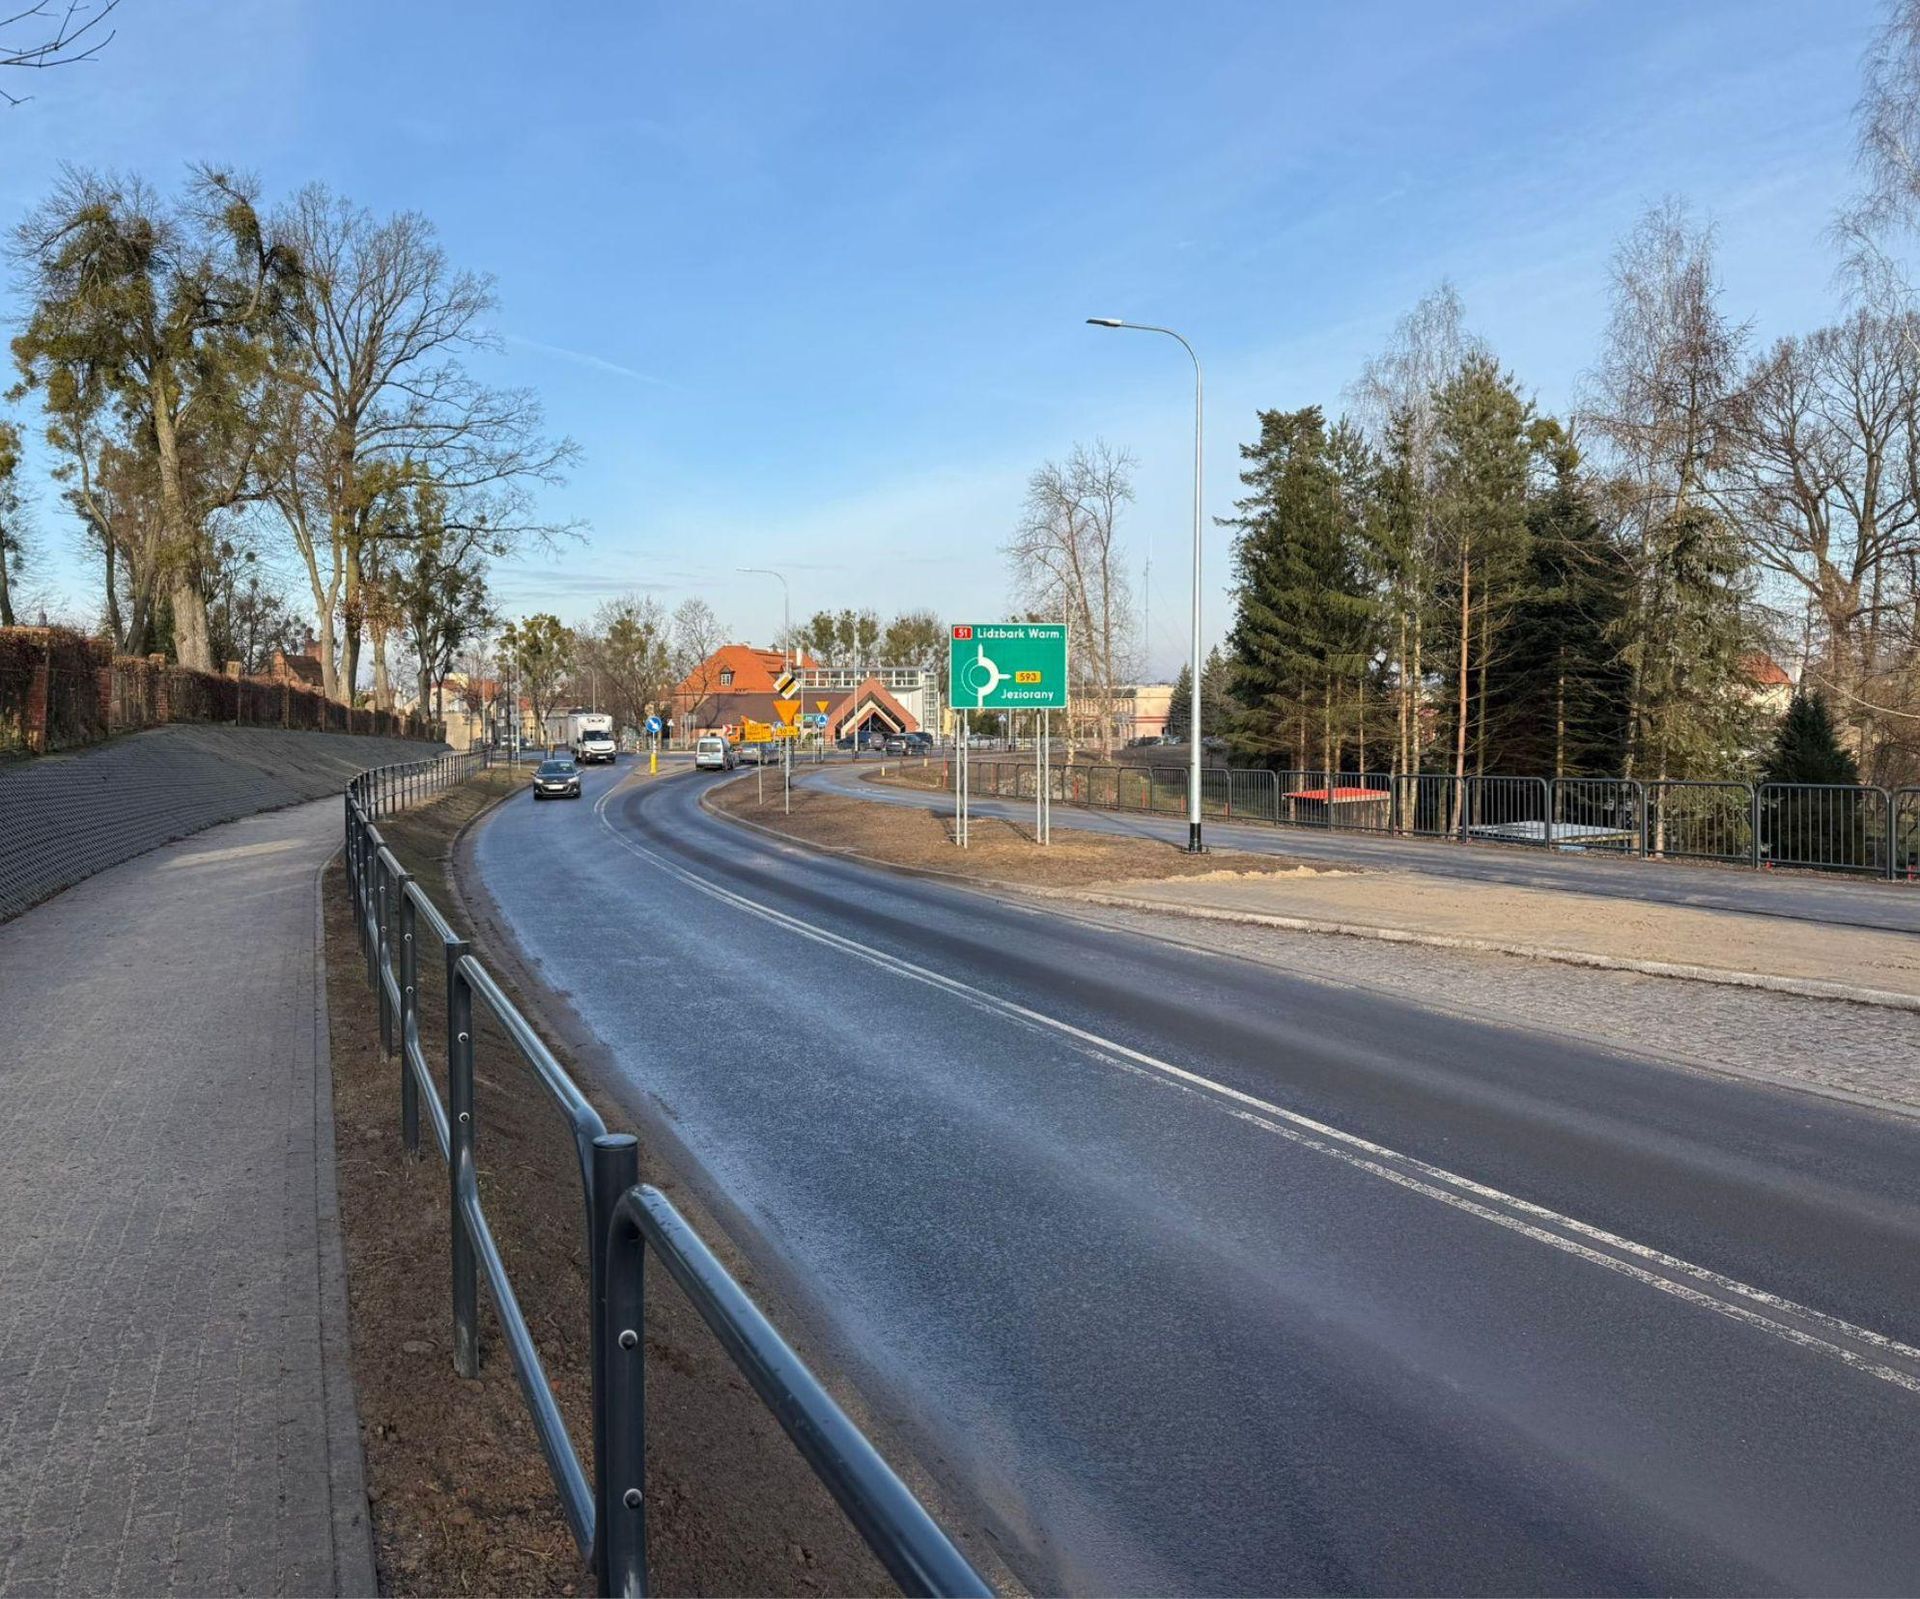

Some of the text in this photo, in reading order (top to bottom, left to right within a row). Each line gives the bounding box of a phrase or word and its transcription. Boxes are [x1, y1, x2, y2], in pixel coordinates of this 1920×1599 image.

[957, 627, 1063, 639] 51 Lidzbark Warm.
[1019, 673, 1037, 681] 593
[1001, 688, 1054, 701] Jeziorany
